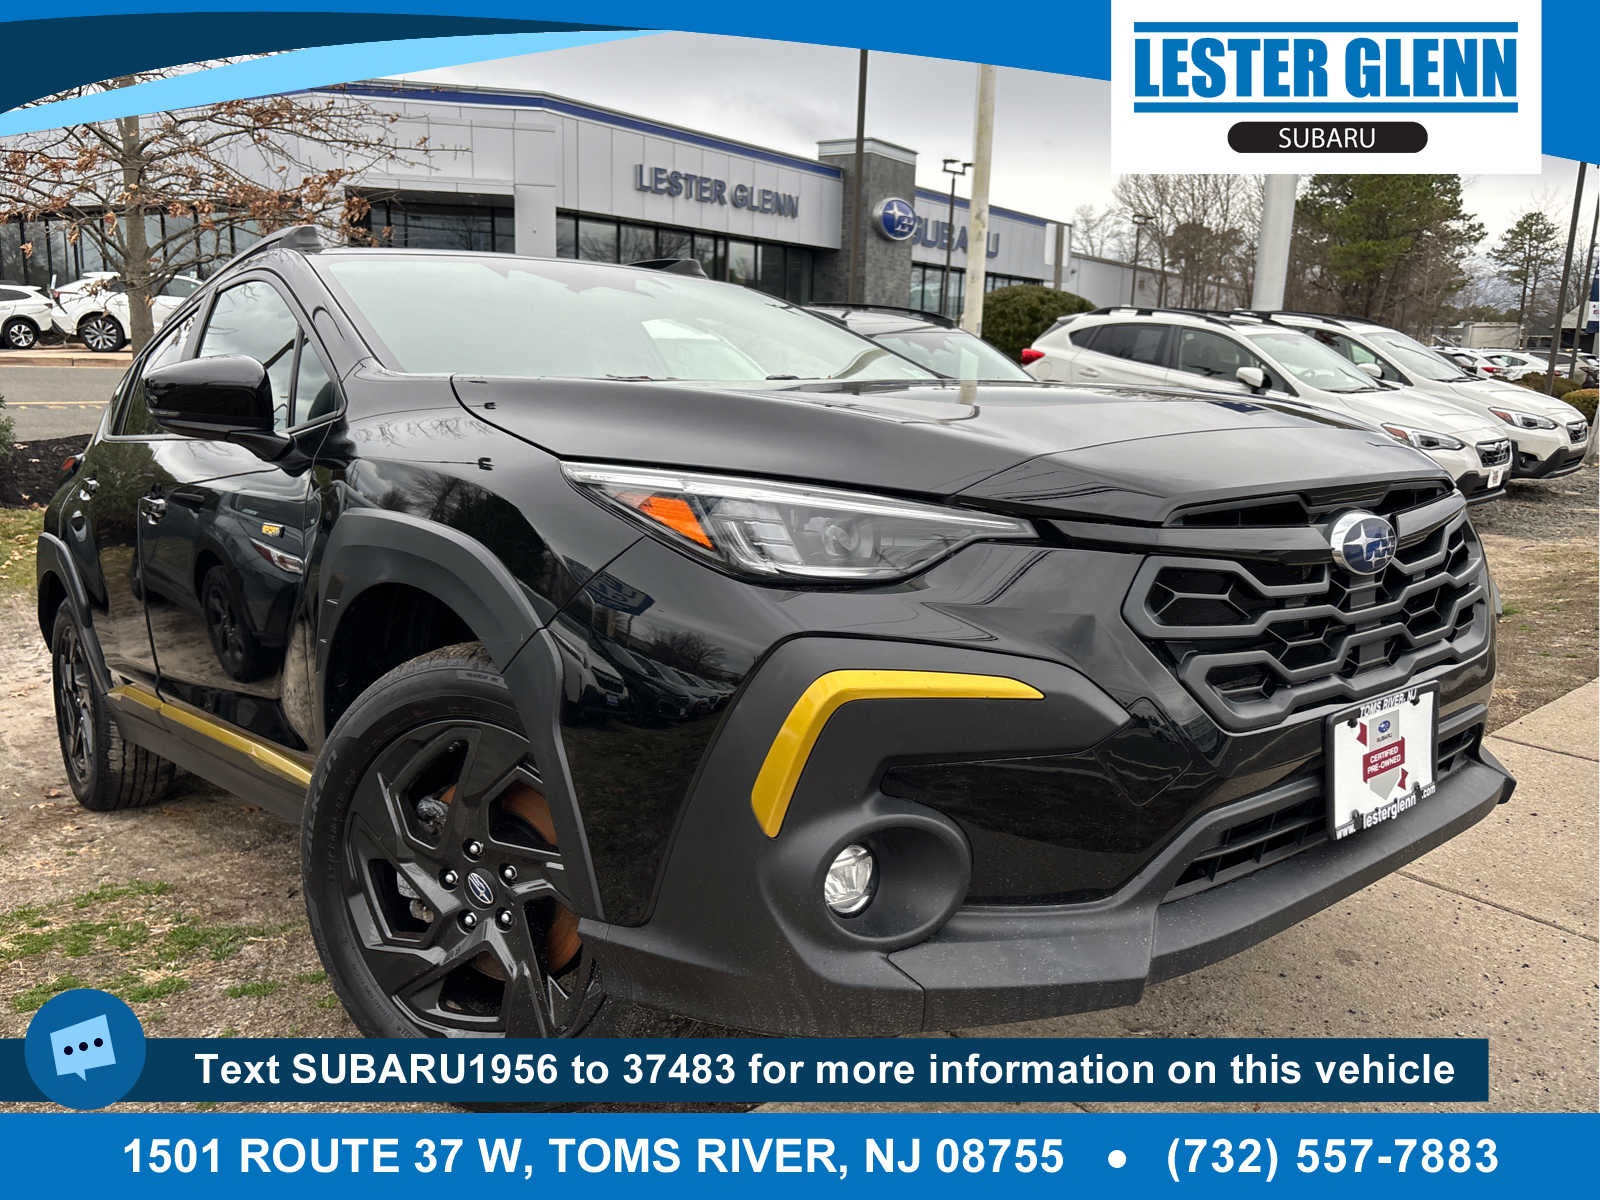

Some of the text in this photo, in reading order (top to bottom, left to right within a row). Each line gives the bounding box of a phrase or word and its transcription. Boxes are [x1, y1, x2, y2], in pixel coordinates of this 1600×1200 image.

[634, 164, 799, 219] LESTER GLENN
[912, 215, 1000, 259] SUBAU
[1360, 701, 1381, 718] TOMS
[1407, 687, 1417, 702] NJ
[1367, 755, 1401, 775] PRE-OWNED
[1370, 746, 1399, 764] CERTIFIED
[1362, 793, 1417, 829] lesterglenn
